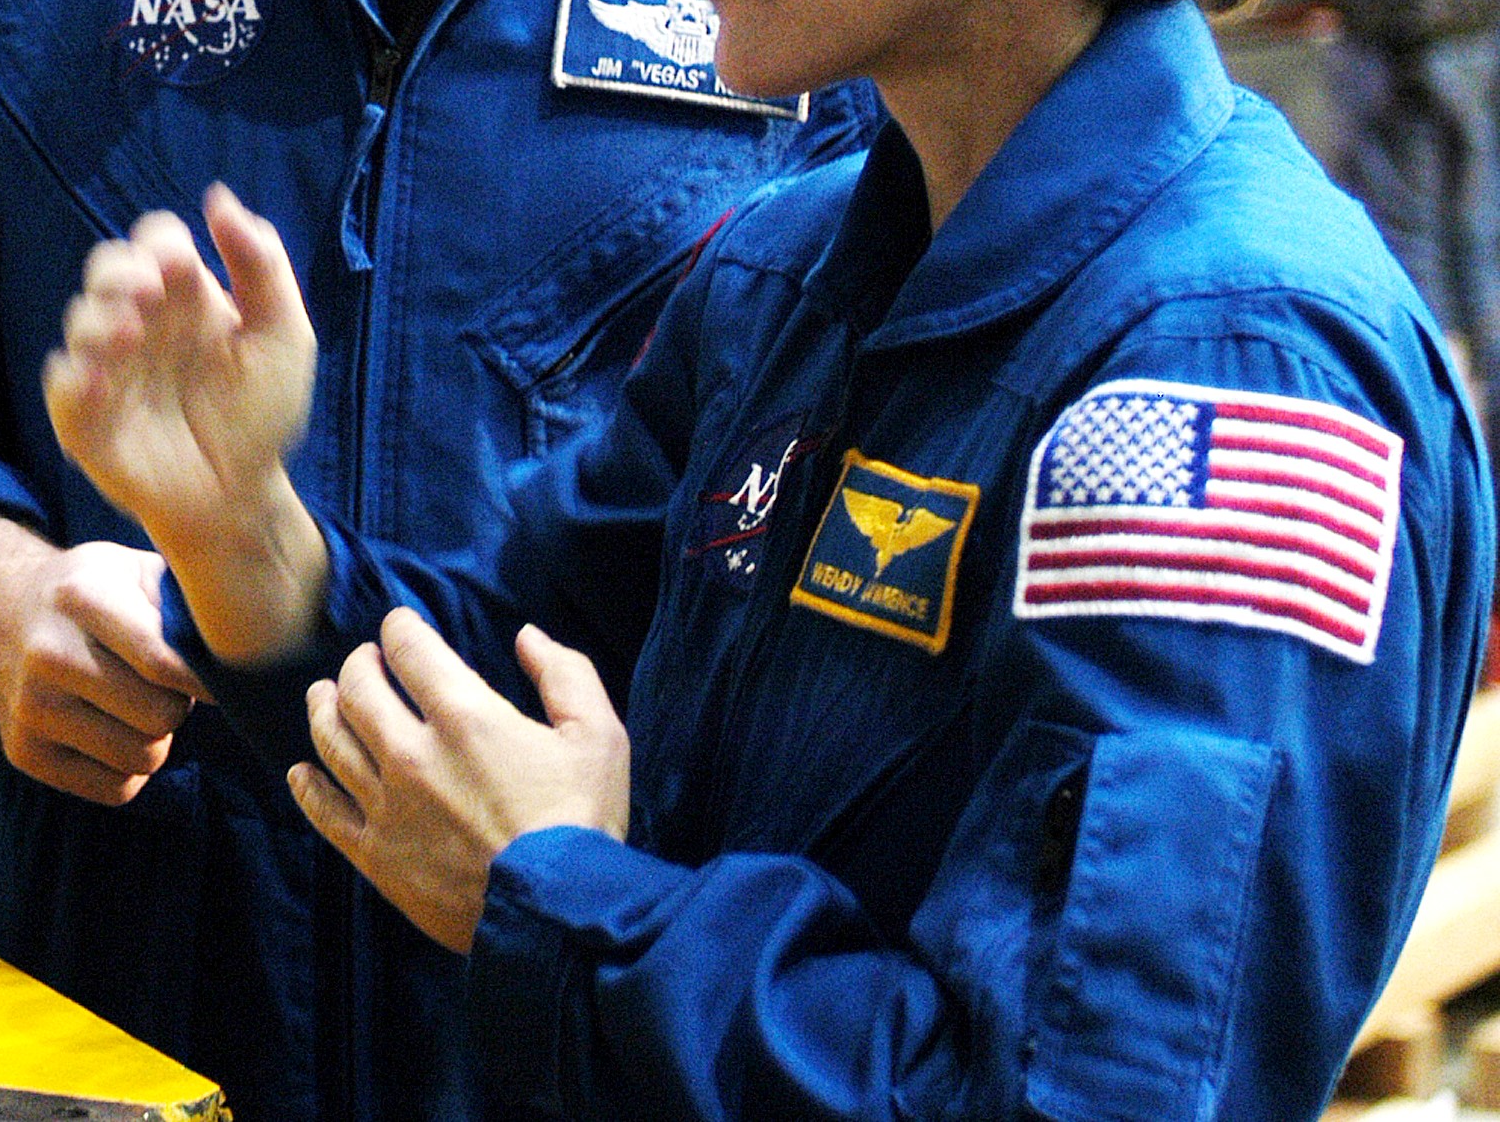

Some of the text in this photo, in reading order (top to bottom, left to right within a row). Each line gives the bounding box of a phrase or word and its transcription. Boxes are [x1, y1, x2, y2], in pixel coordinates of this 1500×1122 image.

[591, 57, 622, 78] JIM
[631, 59, 707, 89] "VEGAS"
[810, 561, 863, 597] WENDY
